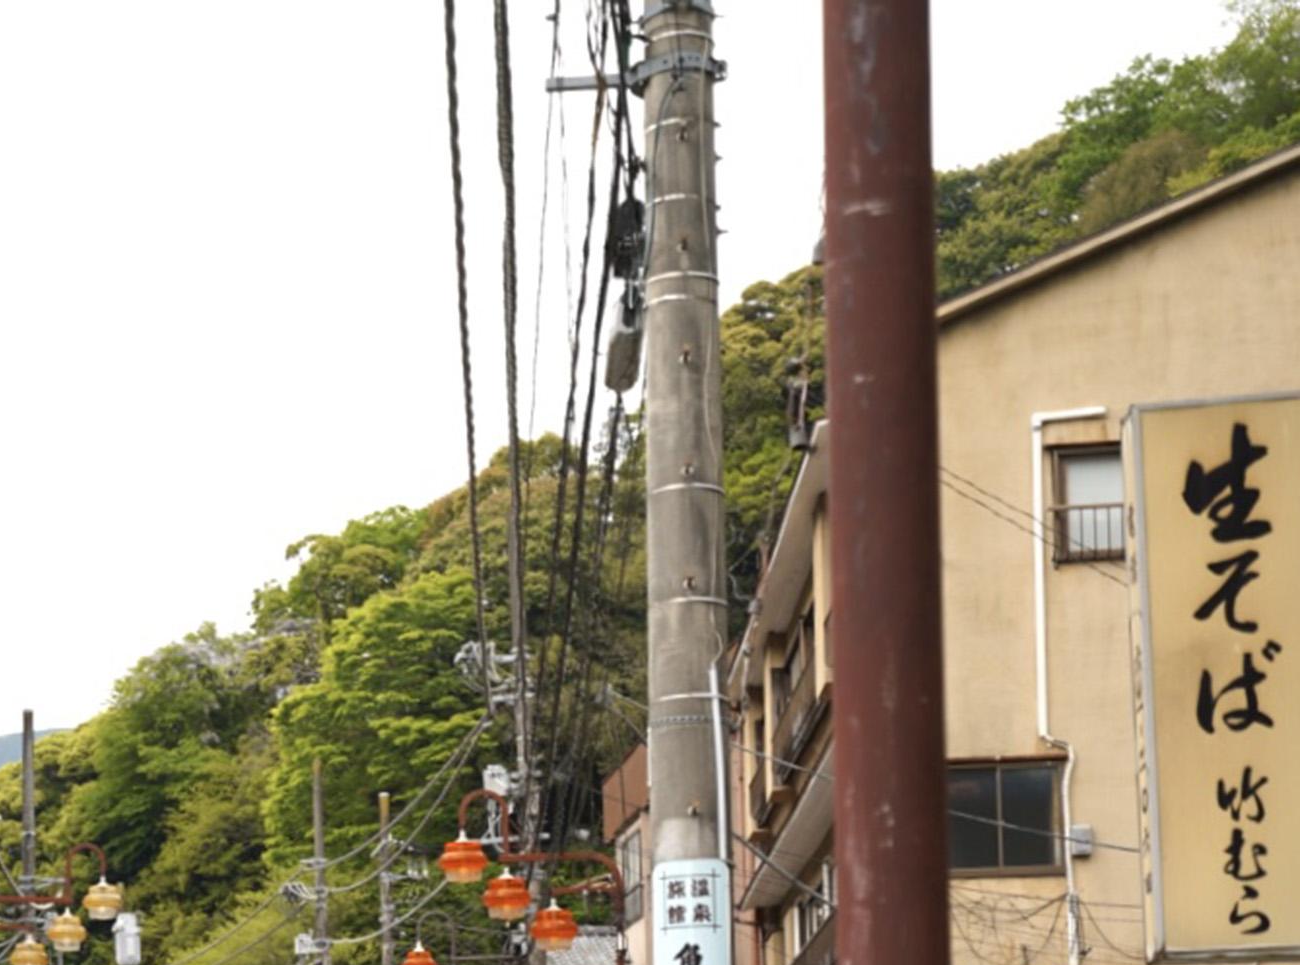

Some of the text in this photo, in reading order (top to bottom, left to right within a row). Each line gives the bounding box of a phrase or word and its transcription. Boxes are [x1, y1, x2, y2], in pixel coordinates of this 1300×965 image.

[1182, 423, 1282, 734] 生そば
[1217, 766, 1270, 934] 竹むら
